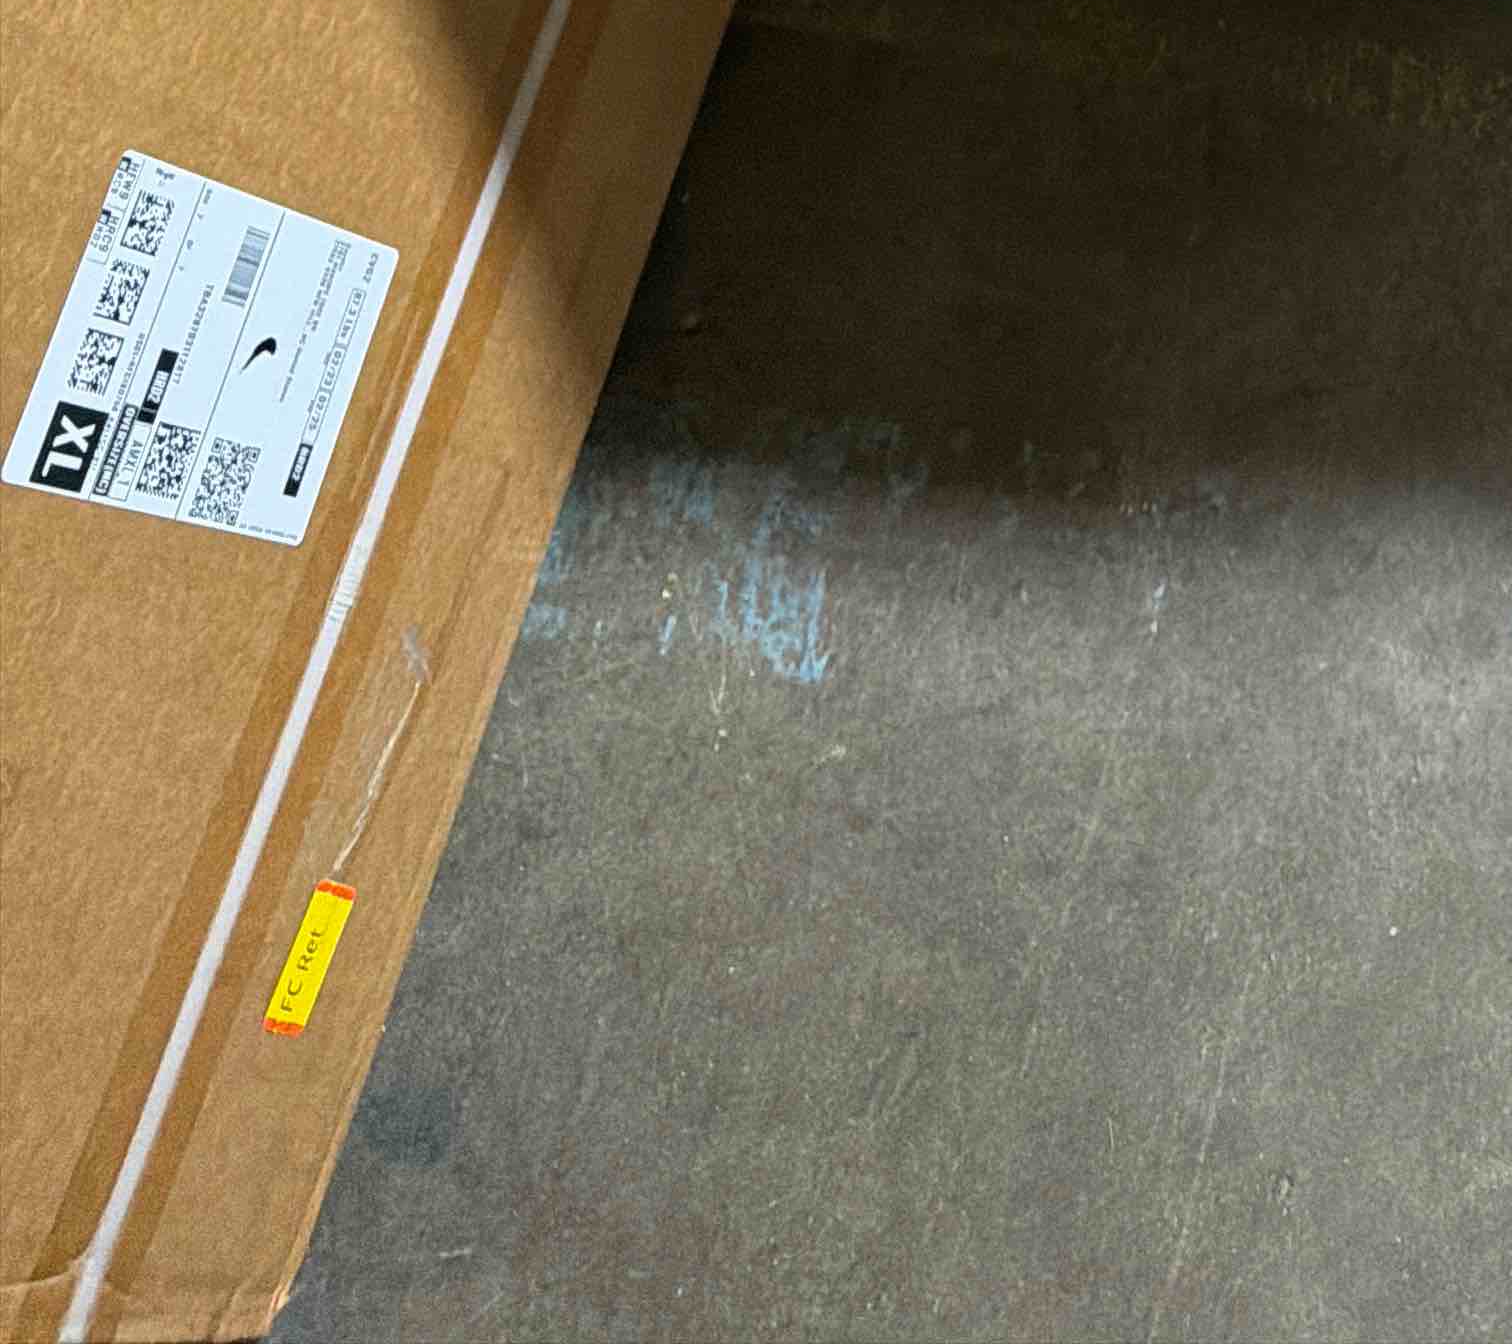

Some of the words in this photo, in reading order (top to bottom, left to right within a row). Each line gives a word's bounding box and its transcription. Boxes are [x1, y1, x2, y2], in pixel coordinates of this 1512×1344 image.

[41, 414, 97, 478] XL
[280, 978, 303, 1013] FC
[297, 928, 324, 971] Ret
